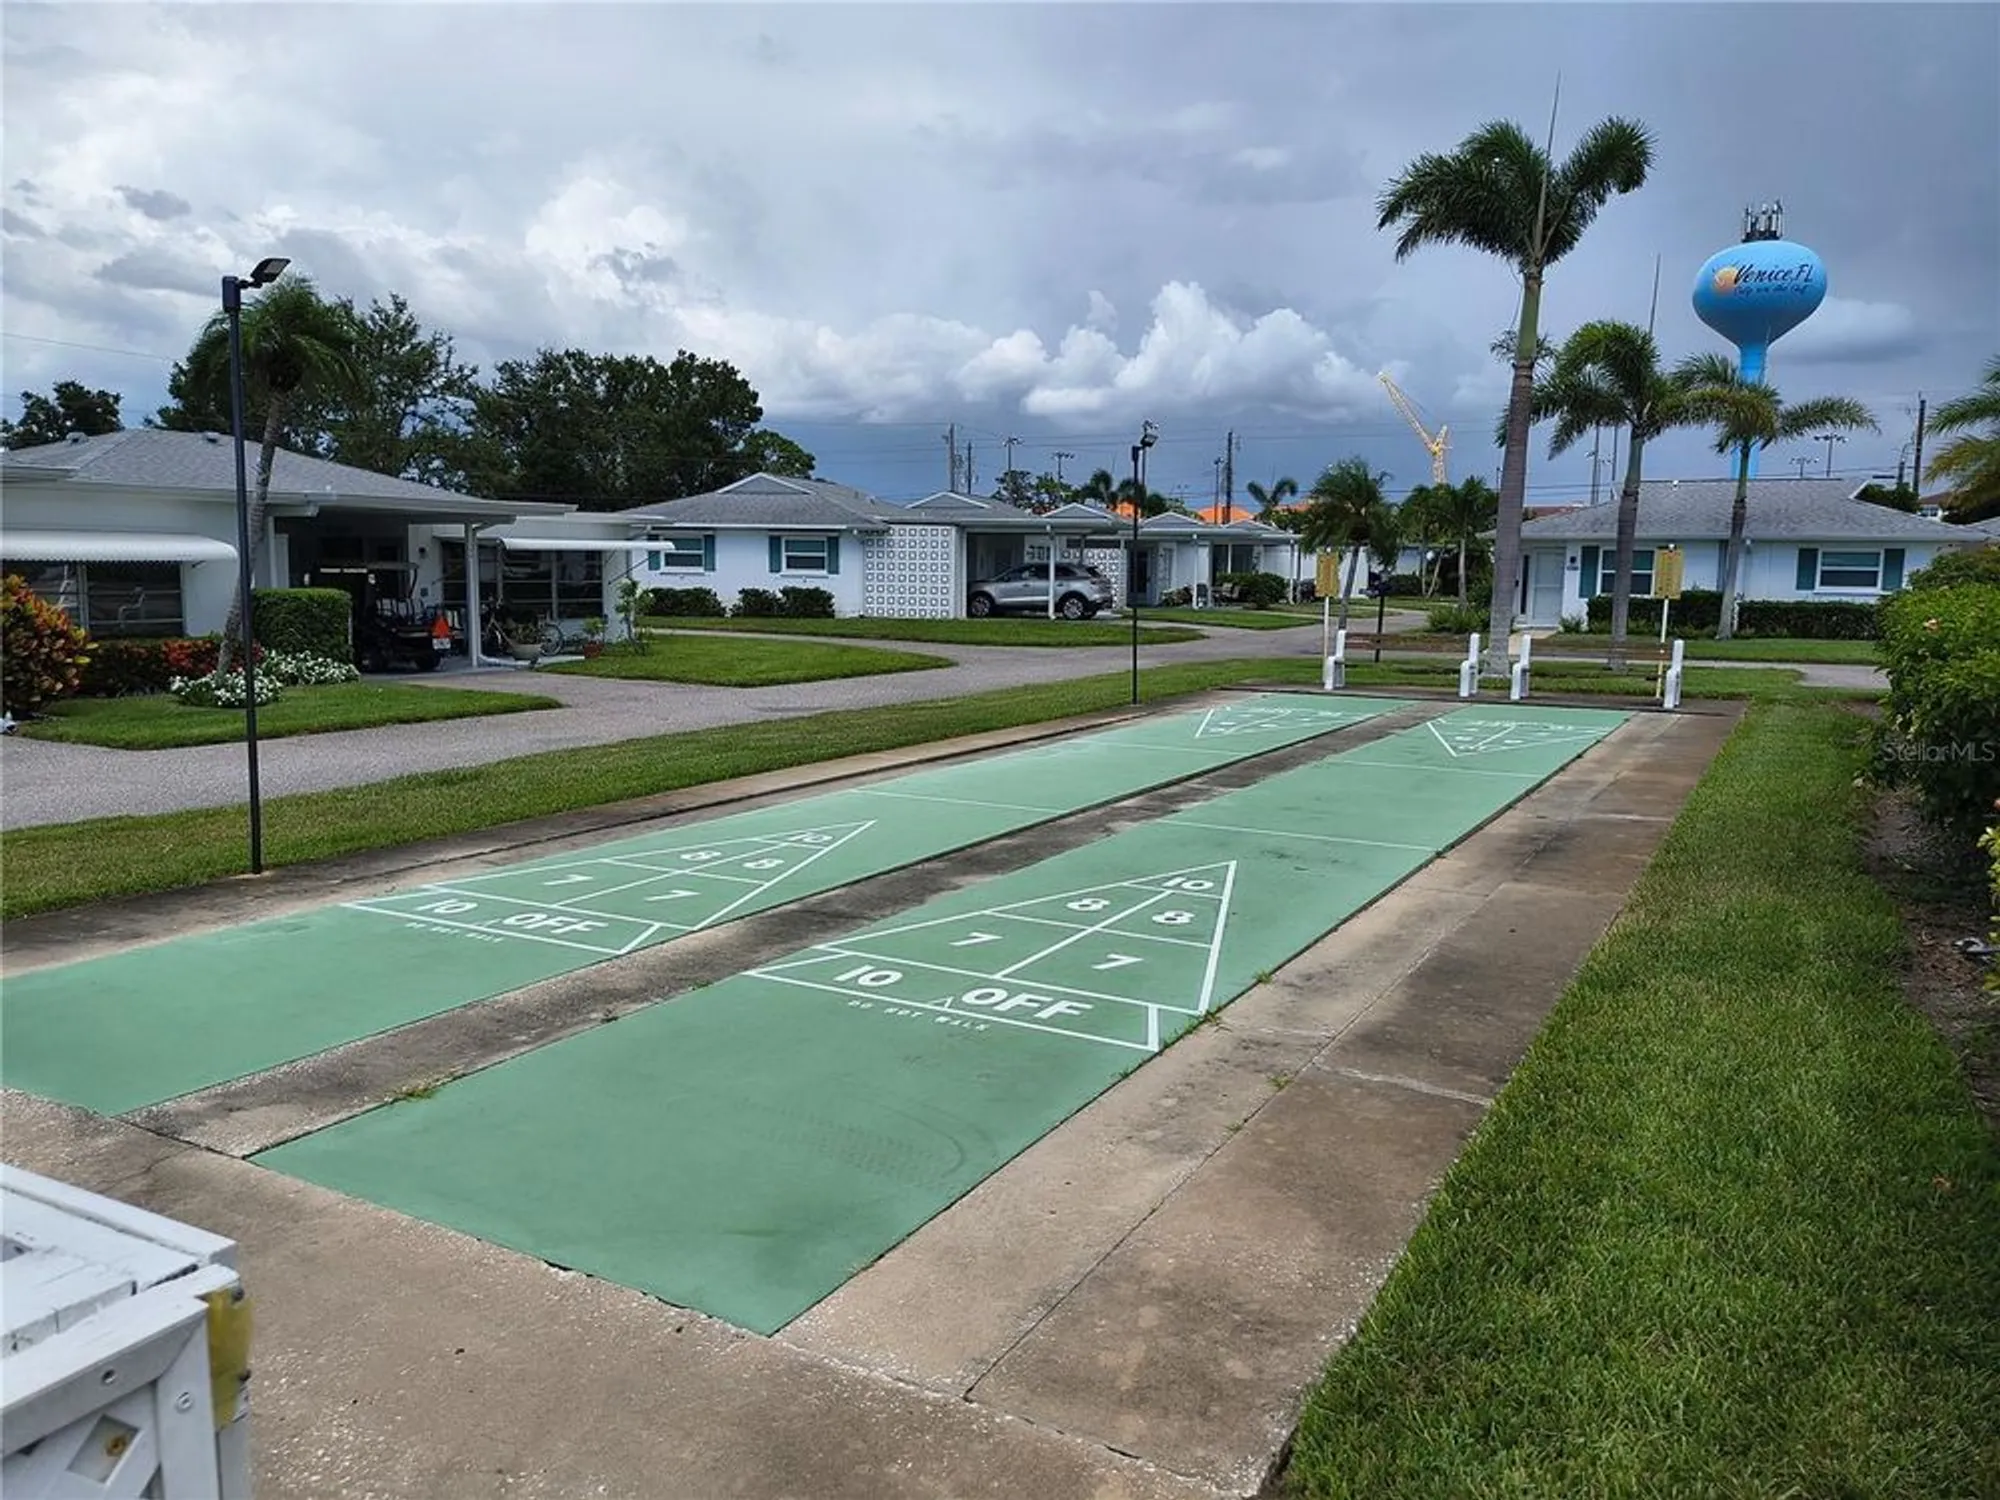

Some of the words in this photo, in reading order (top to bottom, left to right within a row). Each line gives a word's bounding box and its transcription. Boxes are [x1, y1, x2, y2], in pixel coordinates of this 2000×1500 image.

[1163, 877, 1214, 891] 10
[415, 899, 478, 914] 10
[503, 912, 609, 934] OFF
[1066, 898, 1111, 912] 8
[1152, 910, 1196, 925] 8
[949, 931, 1003, 946] 7
[1091, 953, 1144, 970] 7
[833, 965, 903, 987] 10
[962, 988, 1095, 1019] OFF
